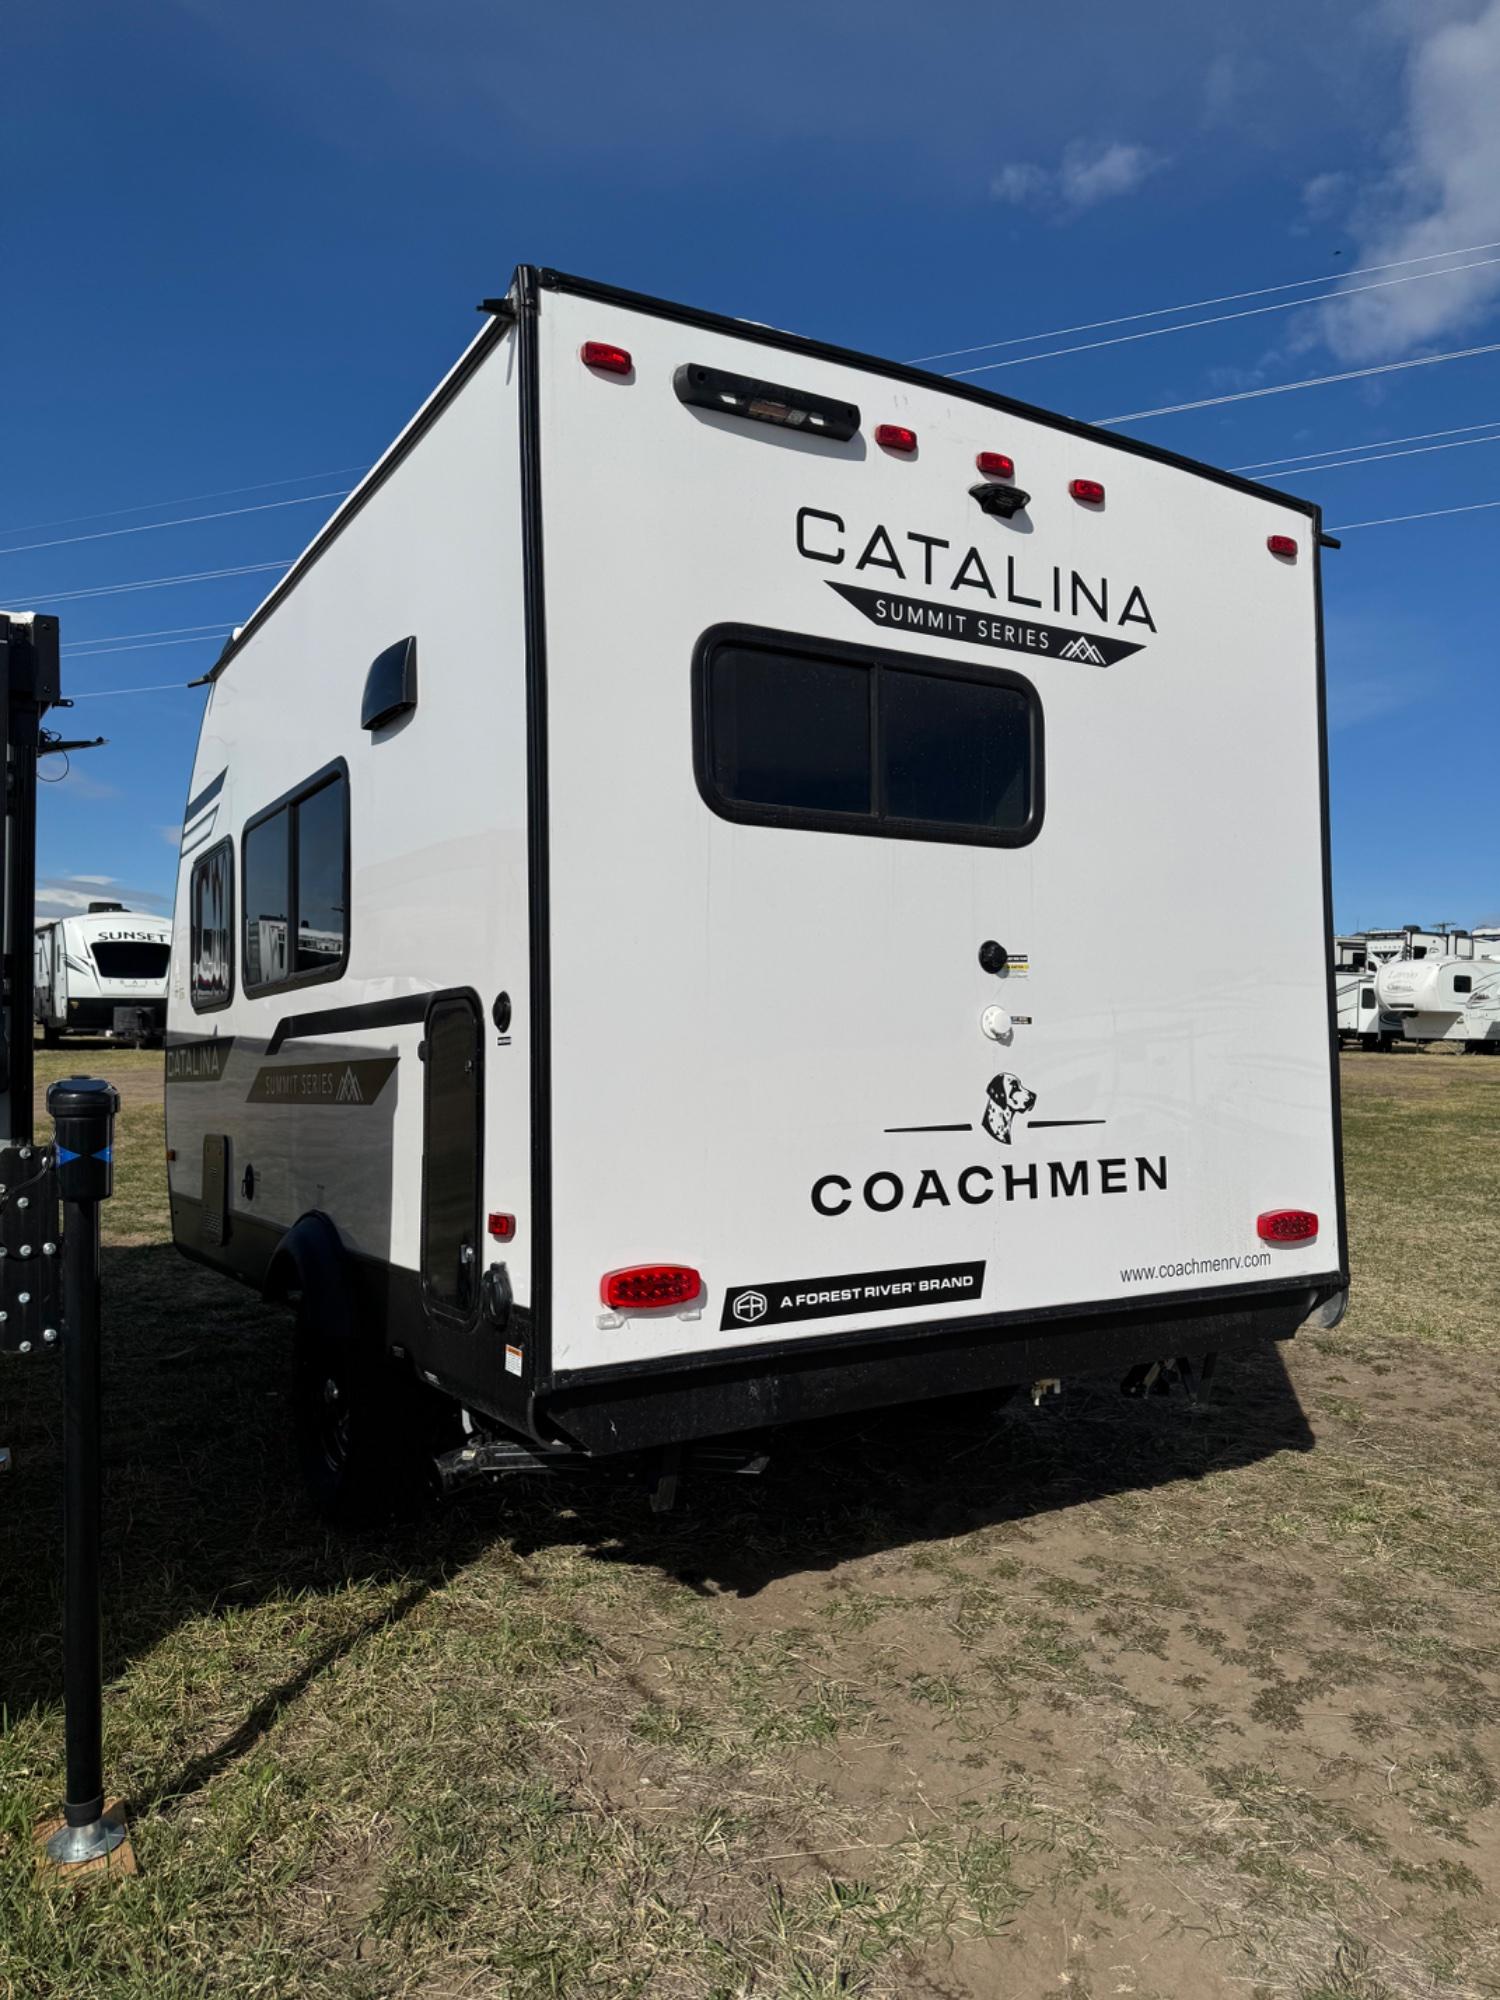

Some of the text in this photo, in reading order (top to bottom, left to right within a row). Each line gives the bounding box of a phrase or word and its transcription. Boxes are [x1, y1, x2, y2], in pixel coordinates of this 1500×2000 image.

[796, 506, 1158, 634] CATALINA
[875, 600, 1050, 649] SUMMIT SERIES
[98, 931, 167, 943] SUNSET
[265, 1072, 334, 1096] SUMMIT SERIES
[810, 1155, 1168, 1217] COACHMEN
[1120, 1253, 1271, 1283] www.coachmenrv.com
[780, 1296, 793, 1309] A
[796, 1287, 862, 1306] FOREST
[918, 1275, 974, 1292] BRAND
